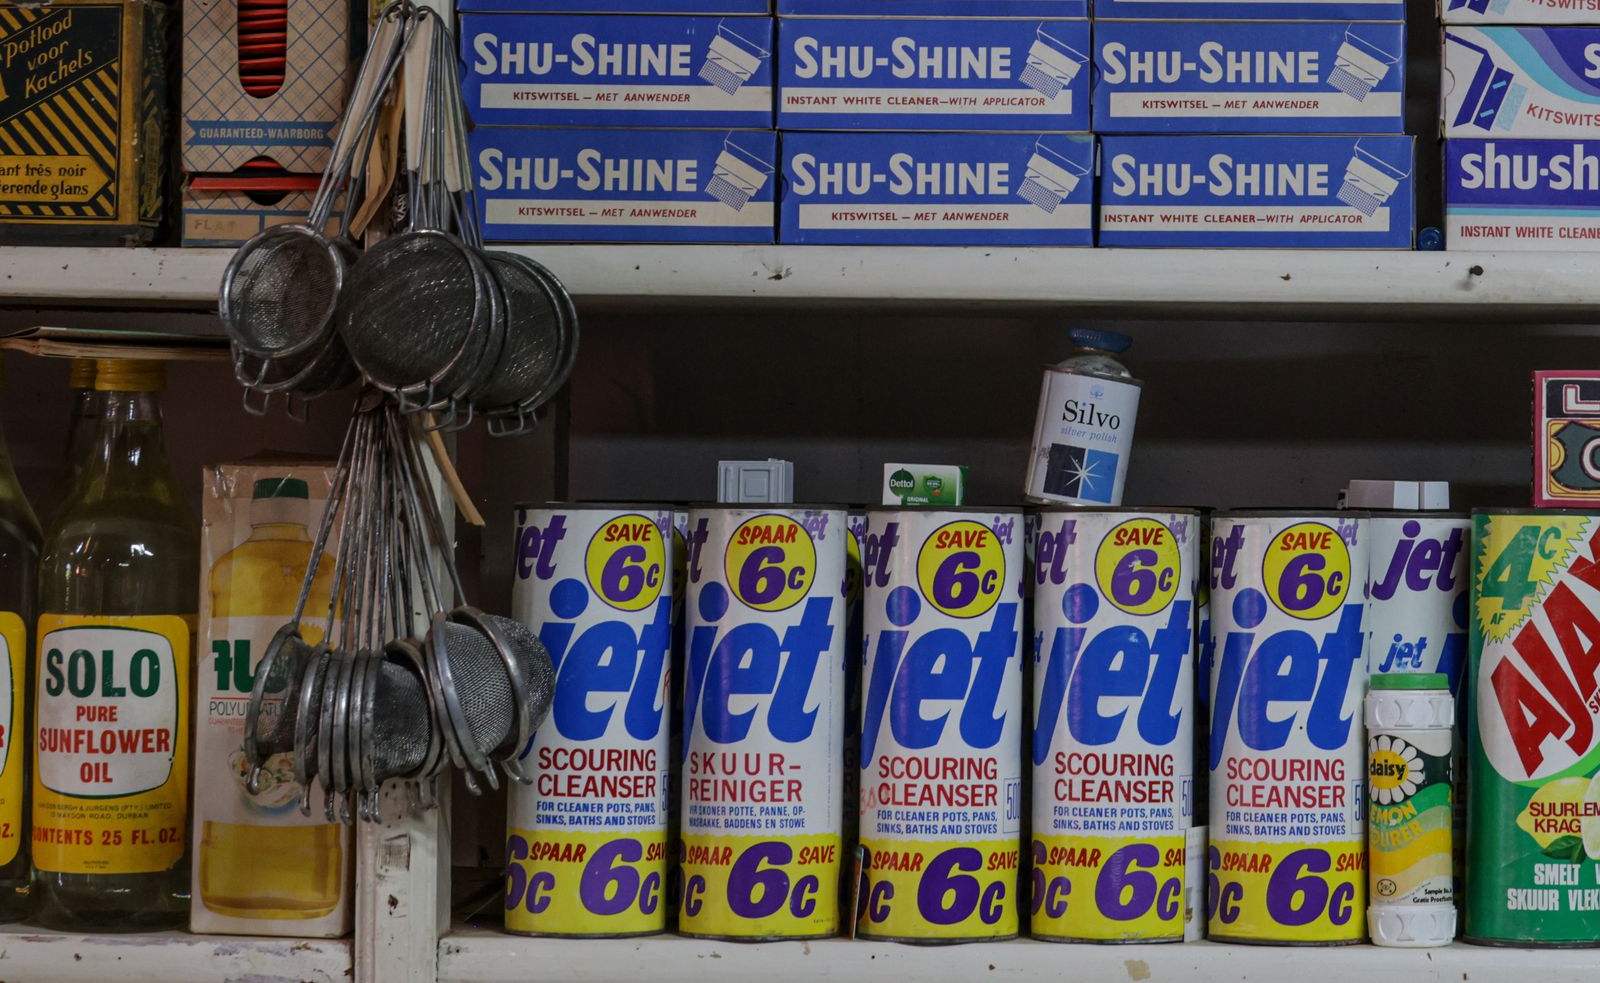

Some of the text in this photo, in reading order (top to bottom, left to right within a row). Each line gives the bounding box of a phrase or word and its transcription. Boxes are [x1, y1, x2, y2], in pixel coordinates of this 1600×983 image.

[6, 13, 72, 66] Potlood
[27, 37, 69, 69] voor
[24, 48, 92, 98] Kachels
[513, 91, 690, 103] KITSWITSEL MET AANWENDER
[200, 127, 323, 139] GUARANTEED-WAARBORG
[1062, 398, 1121, 431] Silvo
[890, 477, 914, 490] Dettol
[737, 524, 798, 546] SPAAR
[935, 530, 988, 549] SAVE
[45, 648, 162, 698] SOLO
[861, 585, 1018, 770] jet
[76, 706, 118, 723] PURE
[40, 729, 171, 754] SUNFLOWER
[80, 762, 113, 783] OIL
[879, 756, 997, 780] SCOURING
[689, 779, 802, 802] REINIGER
[878, 782, 997, 807] CLEANSER
[877, 823, 998, 835] SINKS, BATHS AND STOVES
